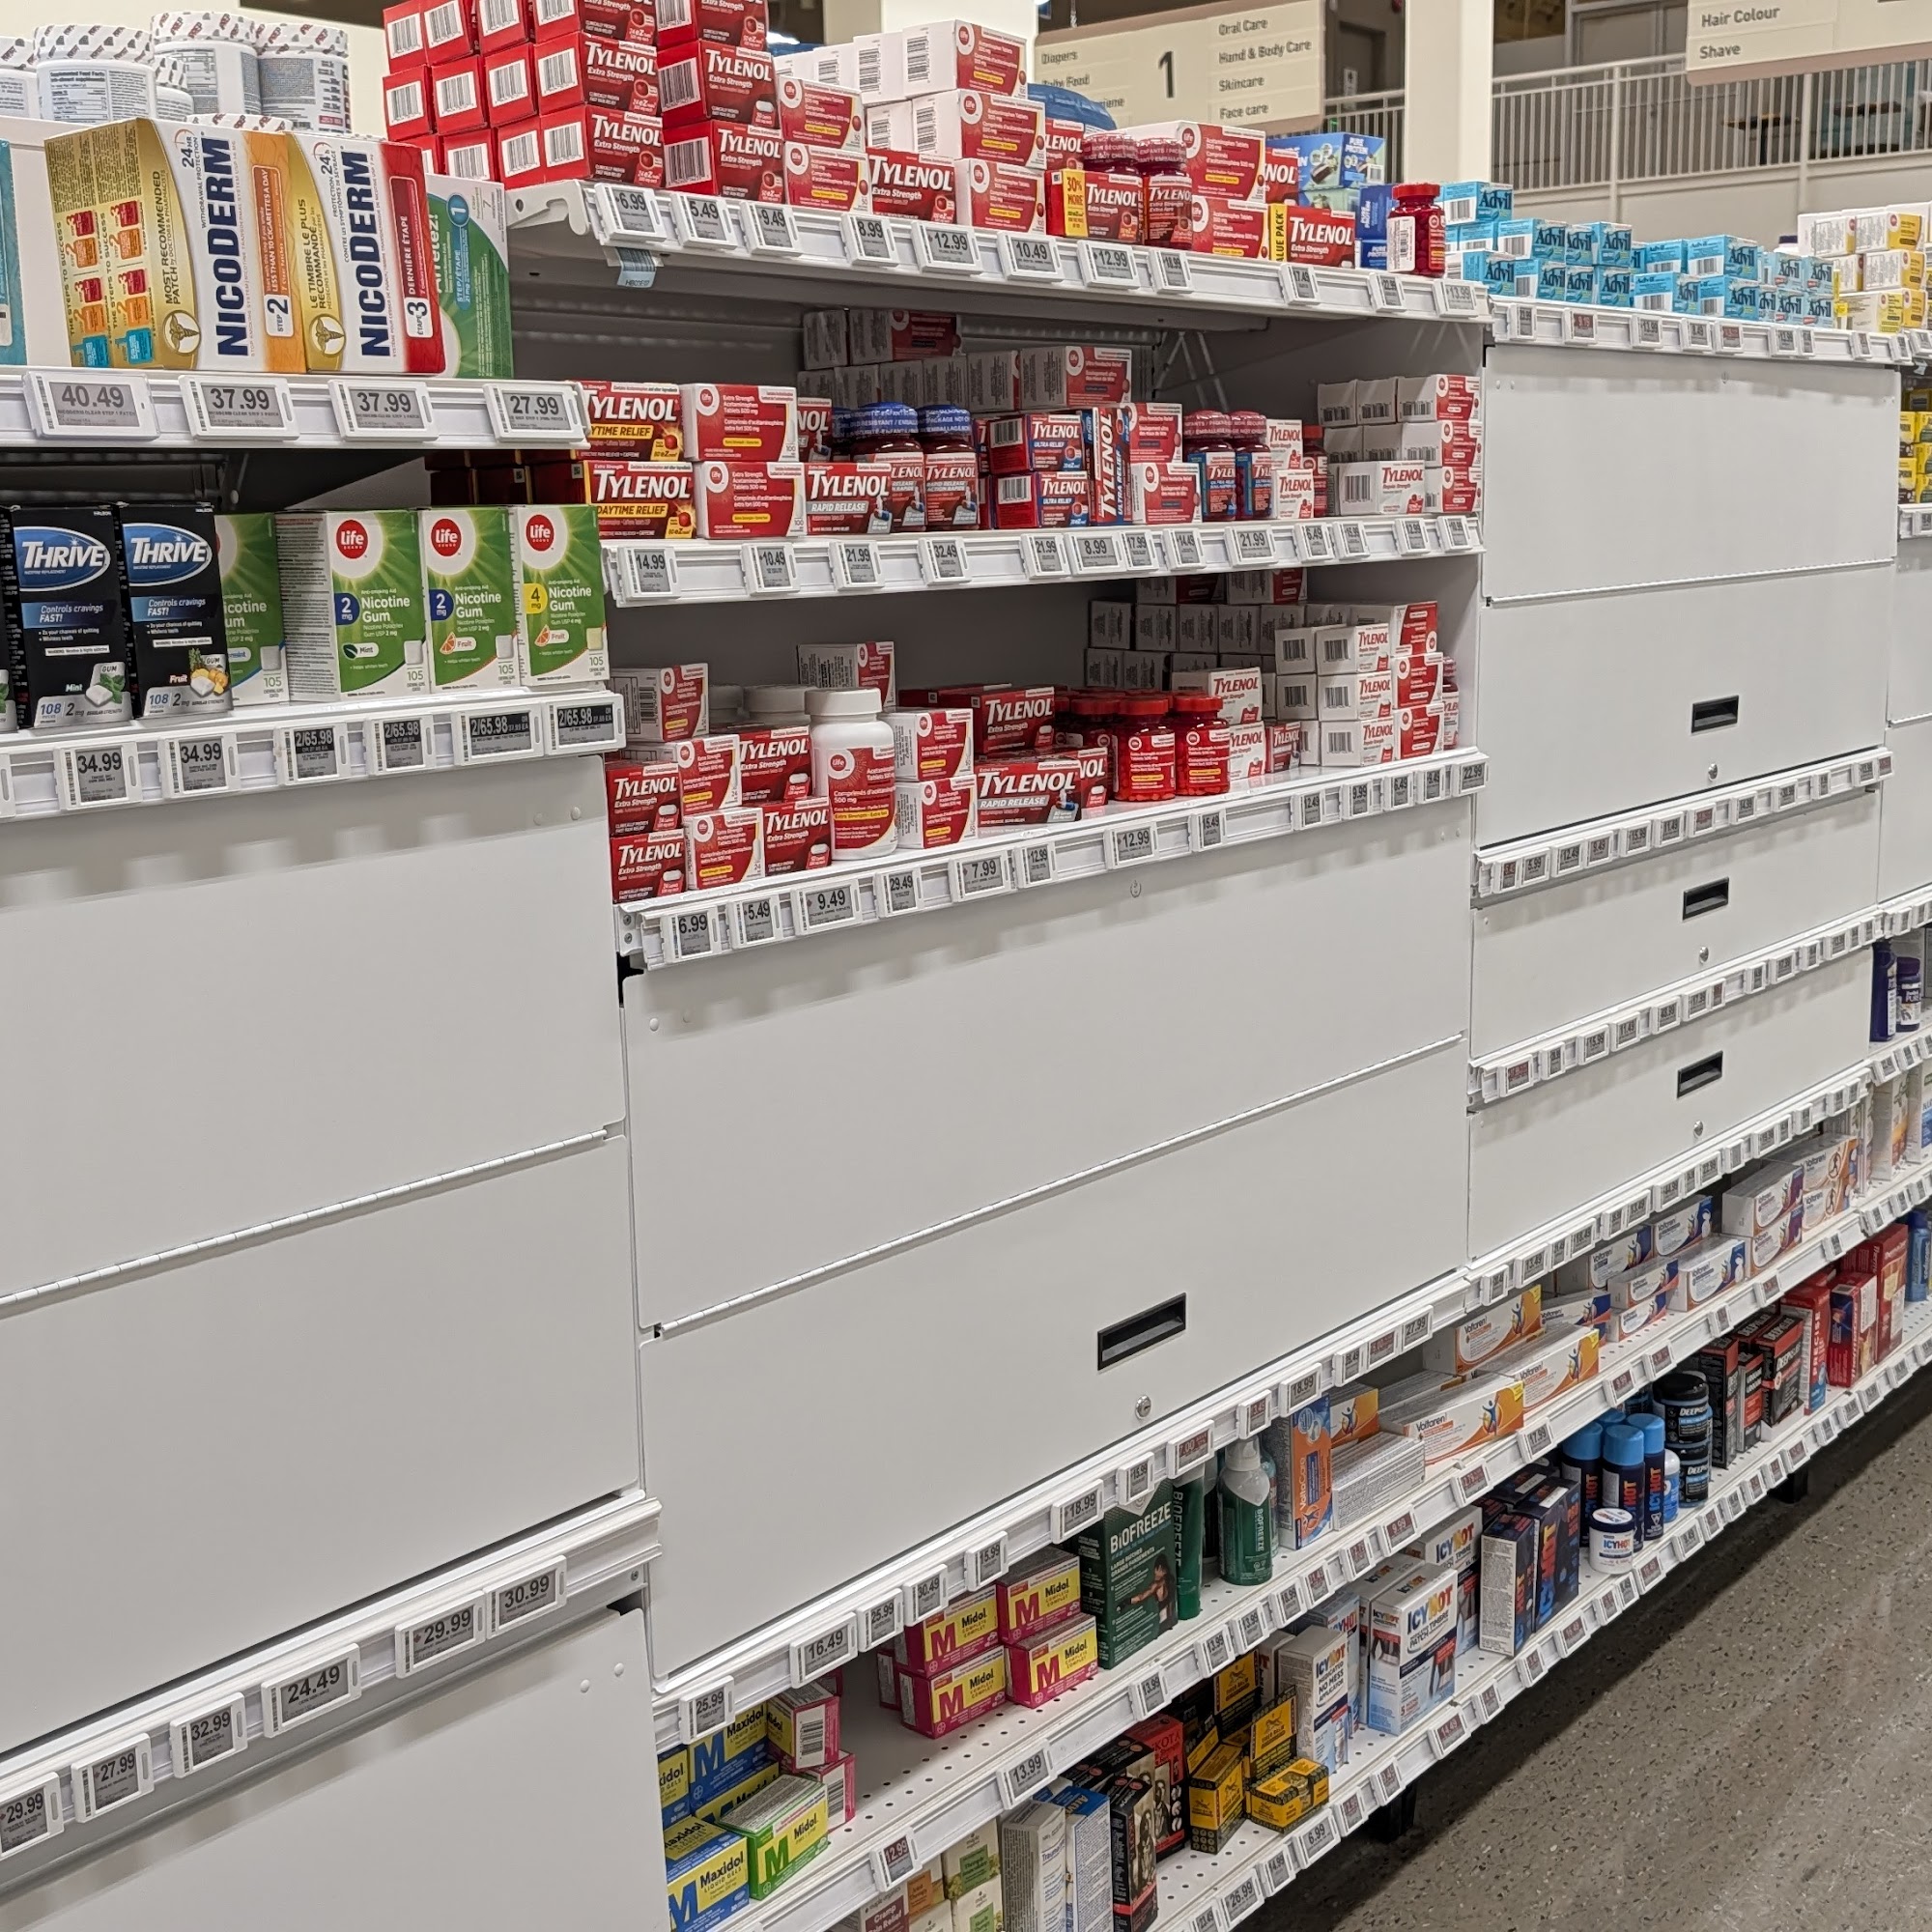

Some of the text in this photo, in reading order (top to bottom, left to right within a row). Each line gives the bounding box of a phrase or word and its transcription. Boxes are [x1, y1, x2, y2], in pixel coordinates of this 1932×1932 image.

[1219, 18, 1267, 36] Oral Care
[1701, 7, 1780, 27] Hair Colour
[584, 41, 656, 75] TYLENOL
[1219, 41, 1312, 64] Hand & Body Care
[1699, 44, 1741, 60] Shave
[587, 67, 635, 82] Extra Strength
[705, 48, 772, 82] TYLENOL
[1158, 51, 1175, 99] 1
[1066, 74, 1090, 87] Food
[1219, 75, 1264, 92] Skincare
[1219, 103, 1268, 120] Face care
[591, 114, 662, 147] TYLENOL
[181, 136, 194, 168] 24 HR
[718, 128, 781, 159] TYLENOL
[192, 136, 207, 229] WITHDRAWAL PROTECTION
[870, 155, 953, 192] TYLENOL
[1066, 177, 1083, 193] 30%
[619, 192, 647, 212] 6.99
[1067, 193, 1084, 207] MORE
[1087, 184, 1137, 207] TYLENOL
[1479, 190, 1512, 211] Advil
[264, 194, 274, 240] CIGARETTES
[690, 199, 720, 220] 5.49
[761, 210, 786, 229] 9.49
[152, 171, 174, 304] MOST RECOMMENDED
[858, 219, 883, 239] 8.99
[1290, 216, 1353, 245] TYLENOL
[57, 221, 67, 266] SUCCESS
[201, 137, 248, 356] NICODERM
[269, 241, 274, 249] 10
[934, 231, 968, 251] 12.99
[1015, 241, 1048, 260] 10.49
[298, 199, 318, 309] LE TIMBRE LE PLUS
[341, 152, 390, 356] NICODERM
[399, 215, 416, 295] DERNIÈRE ÉTAPE
[1098, 251, 1128, 268] 12.99
[62, 269, 68, 281] TO
[1485, 261, 1515, 282] Advil
[267, 298, 289, 314] 2
[407, 301, 427, 317] 3
[61, 385, 126, 409] 40.49
[212, 388, 270, 412] 37.99
[358, 390, 412, 413] 37.99
[510, 394, 559, 415] 27.99
[1033, 421, 1080, 439] TYLENOL
[1269, 425, 1302, 442] TYLENOL
[808, 469, 890, 499] TYLENOL
[1279, 476, 1313, 493] TYLENOL
[1382, 466, 1423, 483] TYLENOL
[593, 469, 691, 502] TYLENOL
[1041, 478, 1087, 496] TYLENOL
[597, 504, 666, 515] DAYTIME RELIEF
[810, 502, 867, 512] RAPID RELEASE
[340, 531, 365, 547] Life
[435, 529, 458, 544] Life
[1241, 531, 1265, 548] 21.99
[21, 541, 106, 569] THRIVE
[130, 537, 209, 565] THRIVE
[845, 547, 870, 563] 21.99
[934, 544, 957, 558] 32.49
[1036, 540, 1056, 554] 21.99
[1085, 539, 1107, 555] 8.99
[636, 554, 667, 570] 14.99
[763, 550, 785, 567] 10.49
[360, 595, 411, 609] Nicotine
[455, 591, 502, 605] Nicotine
[529, 587, 541, 603] 4
[549, 585, 592, 599] Nicotine
[41, 604, 103, 614] Controls cravings
[147, 607, 170, 616] FAST!
[148, 598, 206, 609] Controls cravings
[340, 596, 352, 614] 2
[456, 605, 484, 619] Gum
[549, 598, 576, 612] Gum
[39, 613, 63, 623] FAST!
[341, 612, 354, 622] mg
[361, 610, 391, 624] Gum
[206, 656, 220, 665] GUM
[497, 663, 515, 675] 105
[169, 674, 188, 684] Fruit
[407, 669, 424, 681] 105
[65, 683, 83, 693] Mint
[40, 702, 85, 718] 108 2 mg
[181, 742, 222, 764] 34.99
[77, 752, 123, 775] 34.99
[980, 797, 1046, 809] RAPID RELEASE
[1122, 830, 1150, 847] 12.99
[1031, 849, 1048, 863] 12.99
[972, 860, 997, 876] 7.99
[890, 875, 913, 892] 29.49
[817, 888, 845, 911] 9.49
[748, 901, 771, 920] 5.49
[678, 913, 708, 934] 6.99
[1416, 1413, 1447, 1433] Voltaren
[1298, 1457, 1307, 1509] VoltaCare
[1069, 1492, 1096, 1519] 18.99
[504, 1576, 551, 1608] 30.99
[1044, 1578, 1069, 1598] Midol
[871, 1602, 895, 1623] 25.99
[961, 1608, 988, 1628] Midol
[1015, 1592, 1040, 1630] M
[423, 1609, 472, 1646] 29.99
[809, 1632, 843, 1660] 16.49
[931, 1622, 956, 1660] M
[1064, 1639, 1088, 1660] Midol
[288, 1665, 341, 1706] 24.49
[1318, 1669, 1345, 1694] NO MESS
[696, 1690, 724, 1715] 25.99
[191, 1711, 231, 1740] 32.99
[726, 1705, 765, 1738] Maxidol
[99, 1752, 137, 1782] 27.99
[1014, 1753, 1042, 1780] 13.99
[6, 1794, 44, 1825] 29.99
[1308, 1823, 1326, 1844] 6.99
[885, 1839, 908, 1862] 12.99
[699, 1850, 745, 1889] Maxidol
[873, 1904, 896, 1923] Cramp
[882, 1910, 902, 1929] Relief
